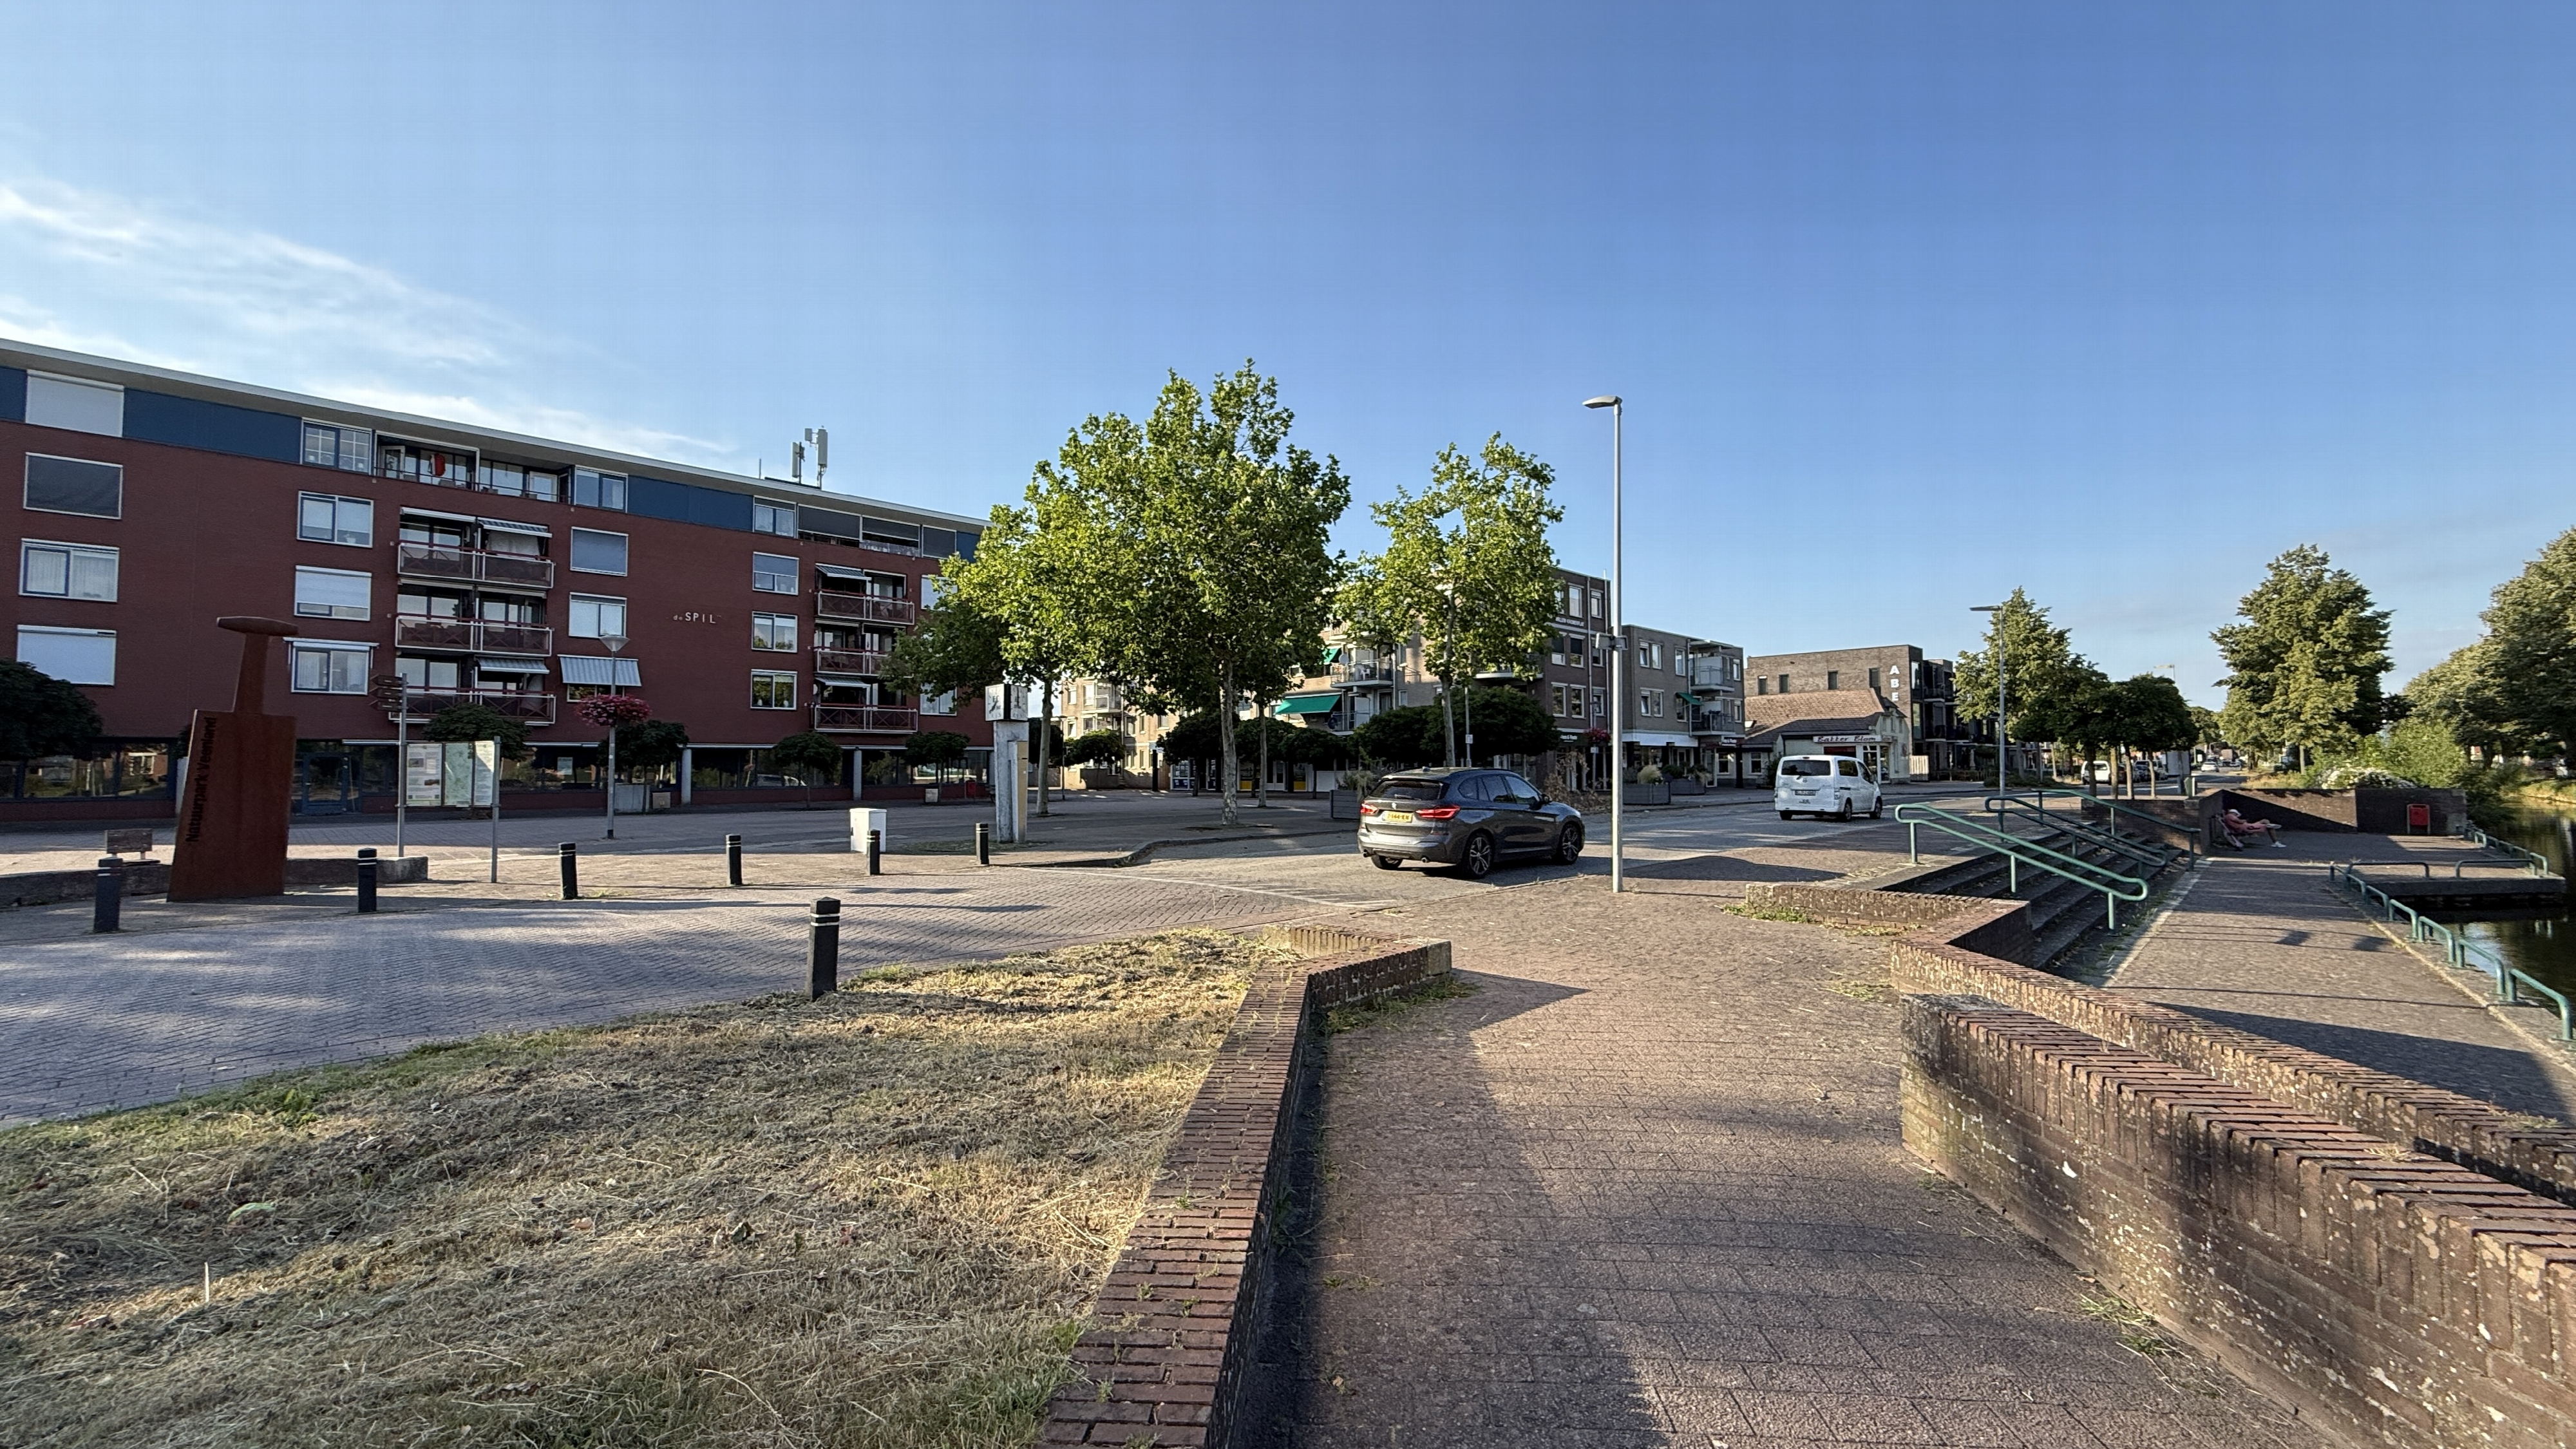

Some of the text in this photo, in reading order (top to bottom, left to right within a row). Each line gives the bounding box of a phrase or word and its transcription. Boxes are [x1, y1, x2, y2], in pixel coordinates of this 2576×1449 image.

[685, 612, 716, 623] SPIL
[1889, 665, 1900, 701] ABE
[185, 717, 217, 842] Natuurpark Veenland
